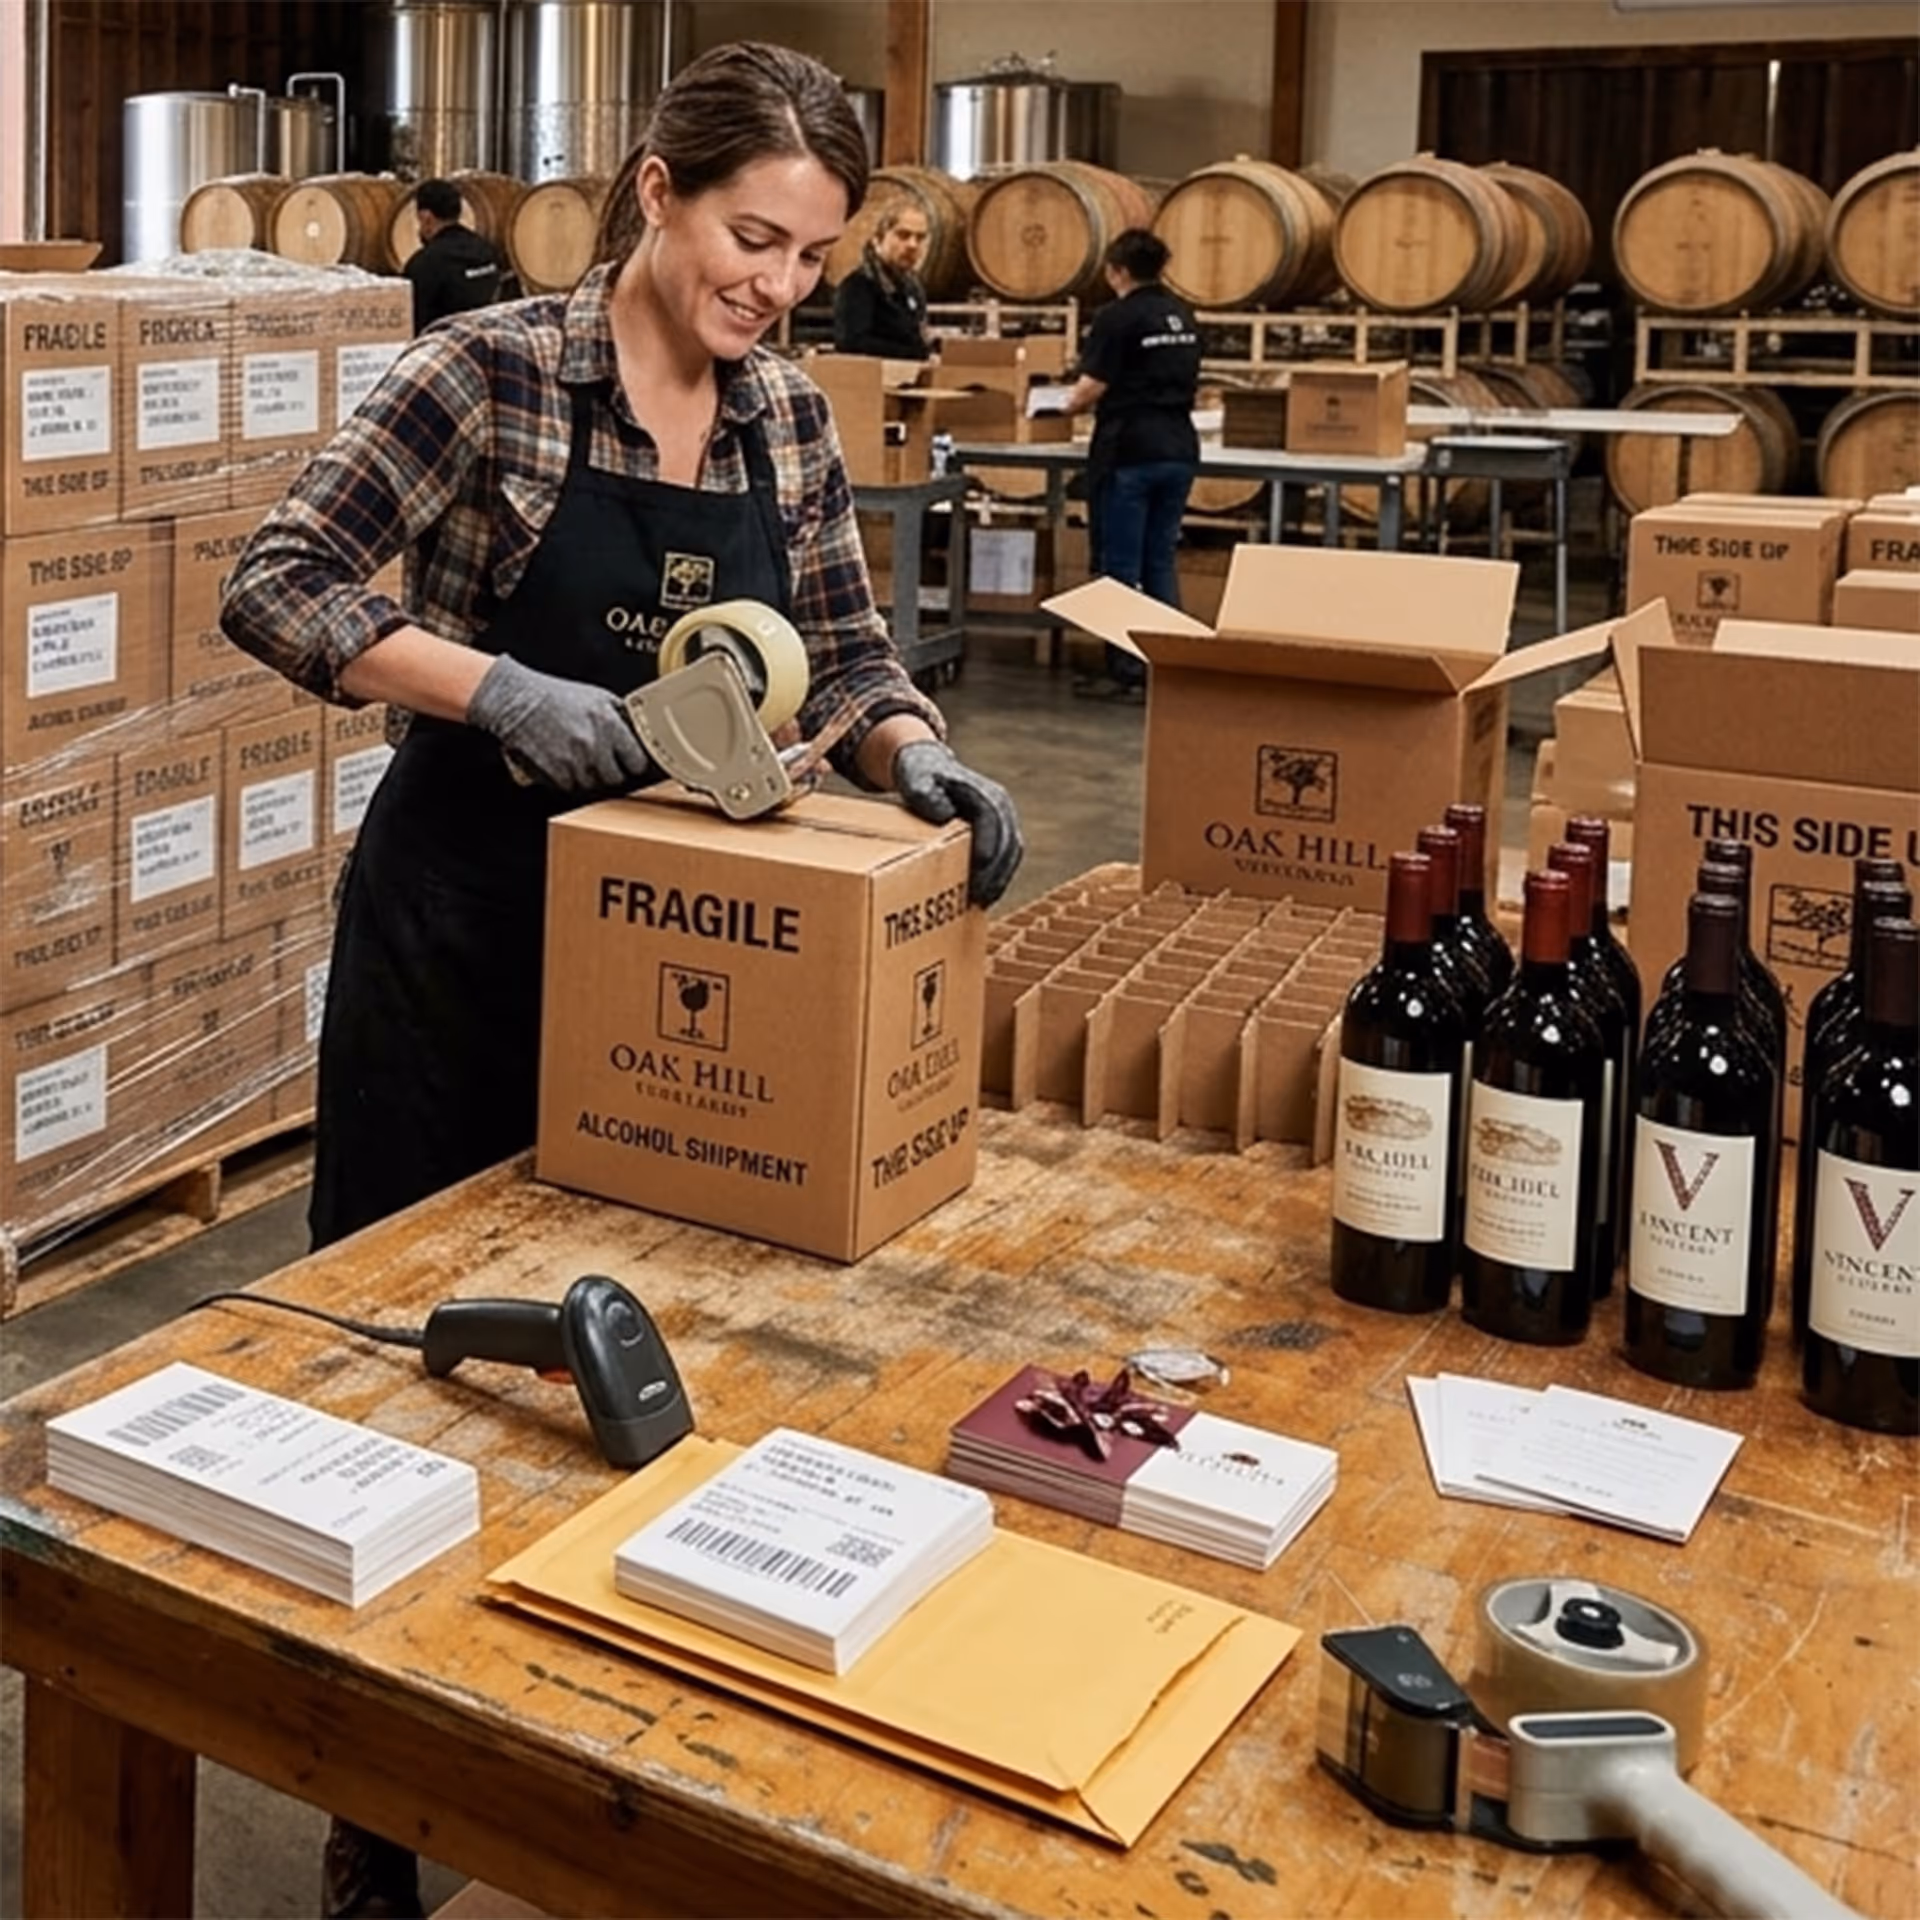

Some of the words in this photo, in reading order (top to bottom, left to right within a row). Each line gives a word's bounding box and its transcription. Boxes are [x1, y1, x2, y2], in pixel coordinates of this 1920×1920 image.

[1204, 822, 1284, 857] OAK
[1298, 833, 1388, 871] HILL
[1686, 804, 1779, 848] THIS
[1793, 817, 1892, 860] SIDE
[599, 876, 801, 954] FRAGILE
[609, 1043, 682, 1083] OAK
[693, 1059, 775, 1103] HILL
[577, 1110, 681, 1157] ALCOHOL
